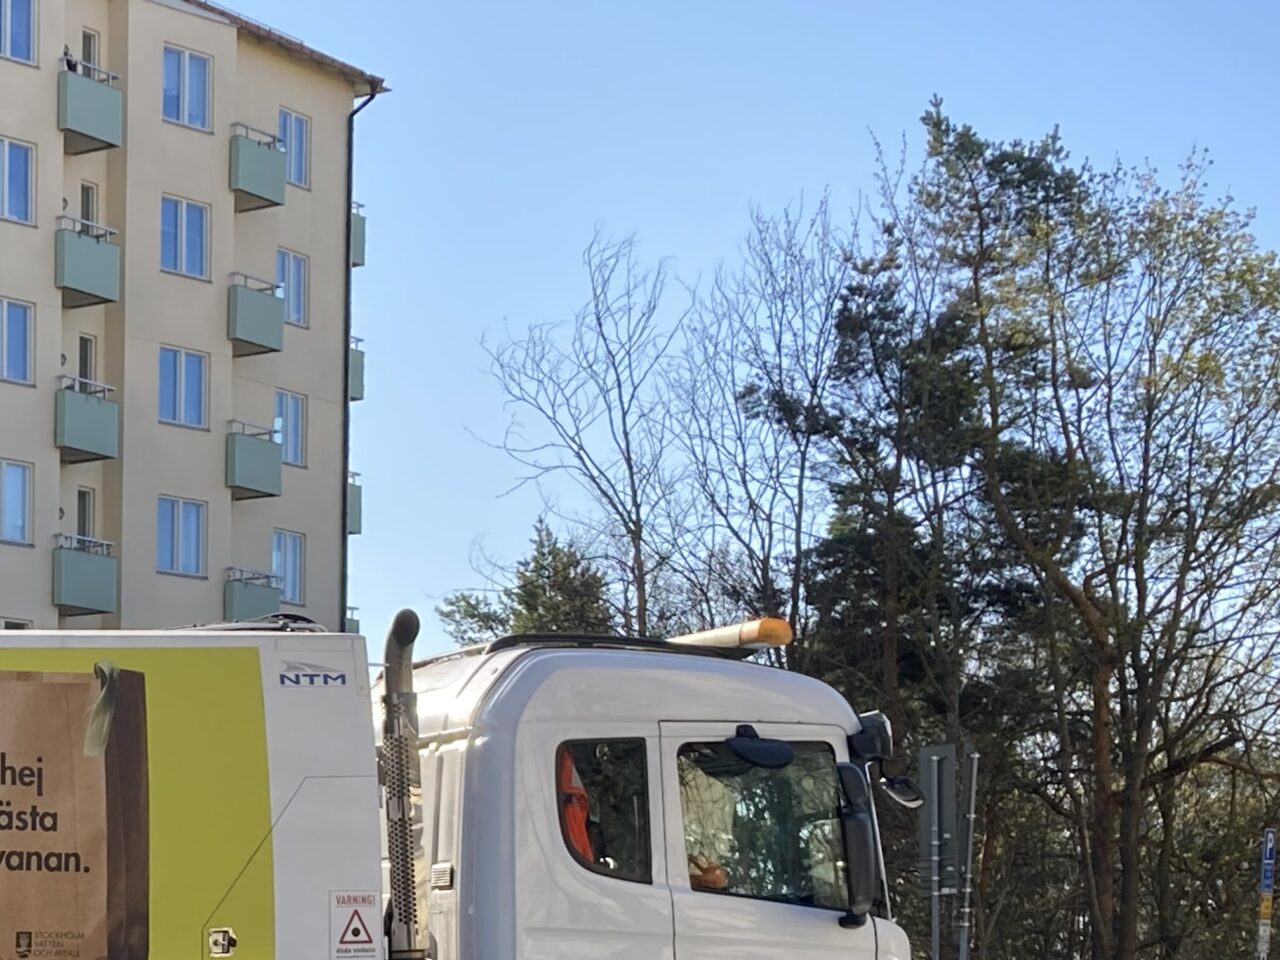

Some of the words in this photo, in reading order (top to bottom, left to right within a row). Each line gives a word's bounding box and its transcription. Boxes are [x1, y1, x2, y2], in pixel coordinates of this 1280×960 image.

[279, 672, 347, 685] NTM
[0, 752, 44, 796] hej
[1267, 833, 1274, 858] P
[335, 894, 376, 905] VARNING!
[34, 931, 85, 939] STOCKHOLM
